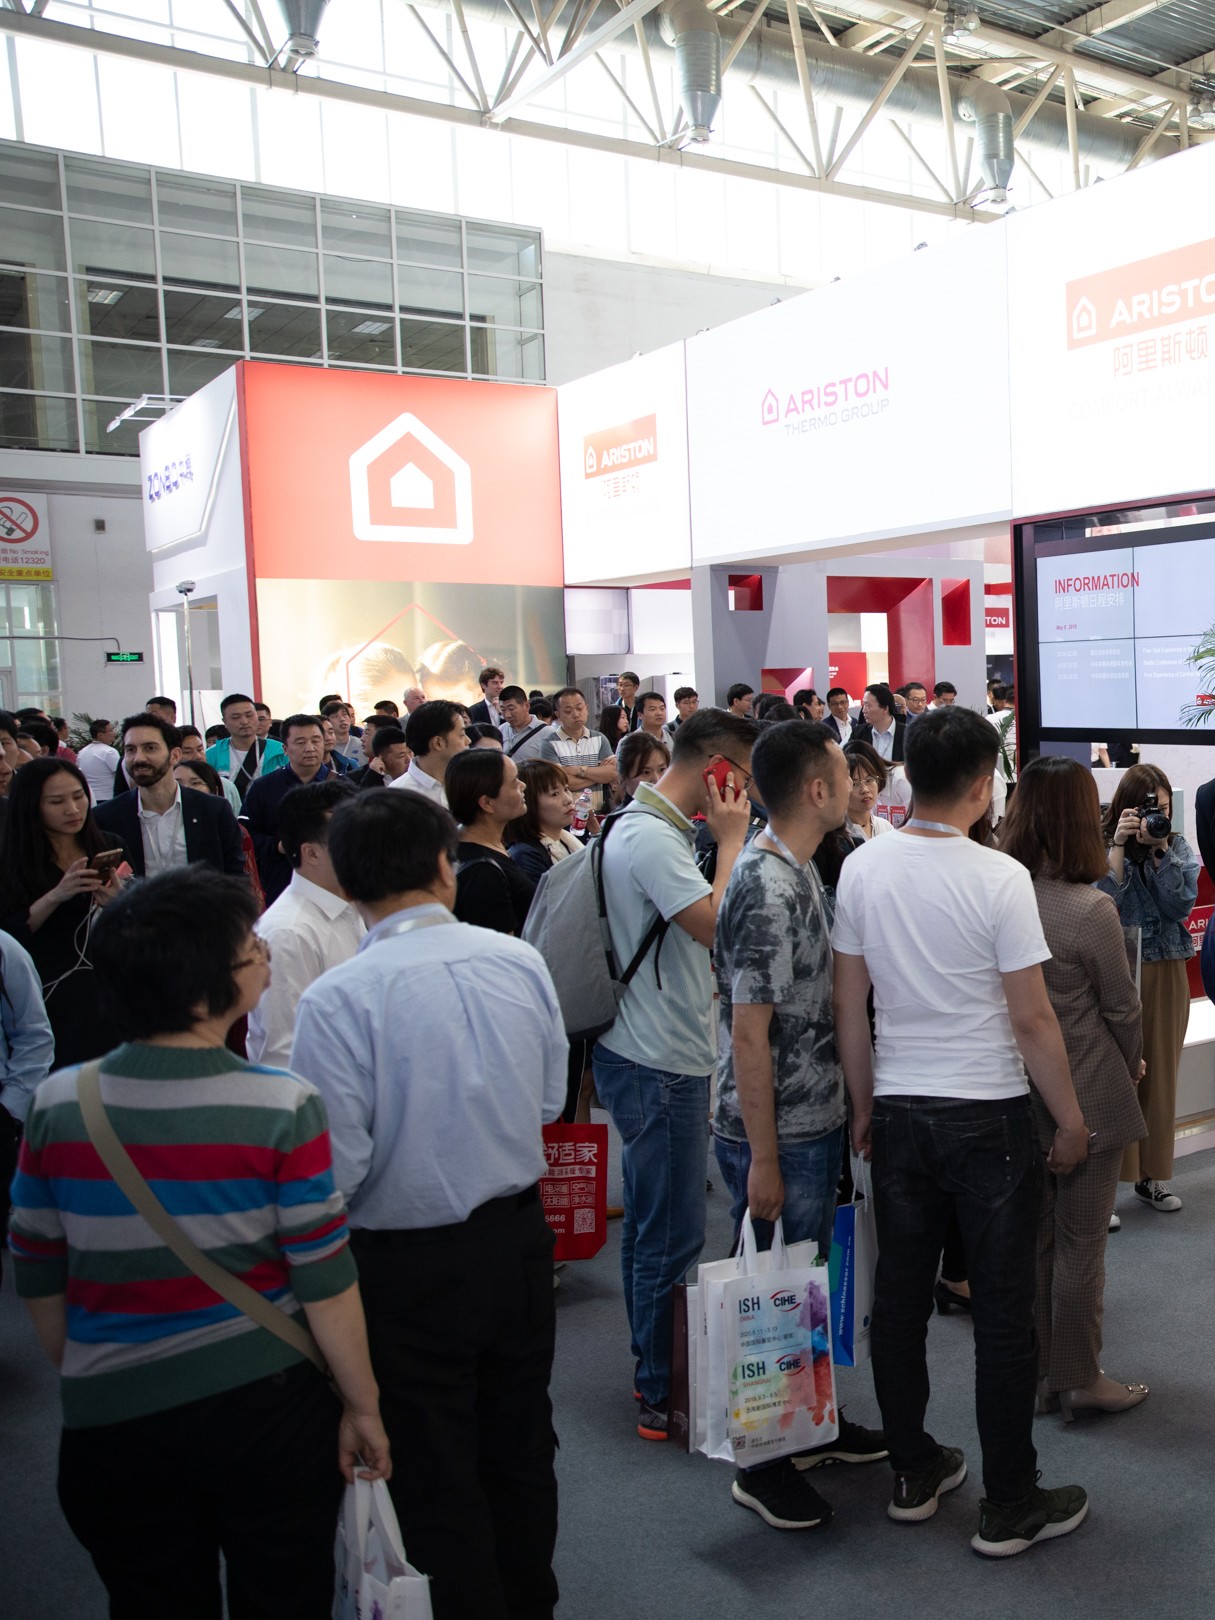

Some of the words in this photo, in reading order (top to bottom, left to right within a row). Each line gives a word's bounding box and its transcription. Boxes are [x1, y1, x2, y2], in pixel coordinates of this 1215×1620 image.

[1113, 325, 1209, 378] 阿里斯顿
[784, 366, 889, 418] ARISTON
[784, 411, 838, 437] THERMO
[841, 398, 890, 423] GROUP
[600, 436, 655, 469] ARISTON
[1055, 571, 1140, 594] INFORMATION
[738, 1296, 761, 1314] ISH
[773, 1294, 797, 1308] CIHE
[742, 1360, 766, 1380] ISH
[779, 1358, 802, 1372] CIHE
[742, 1377, 772, 1389] SHANGHAI
